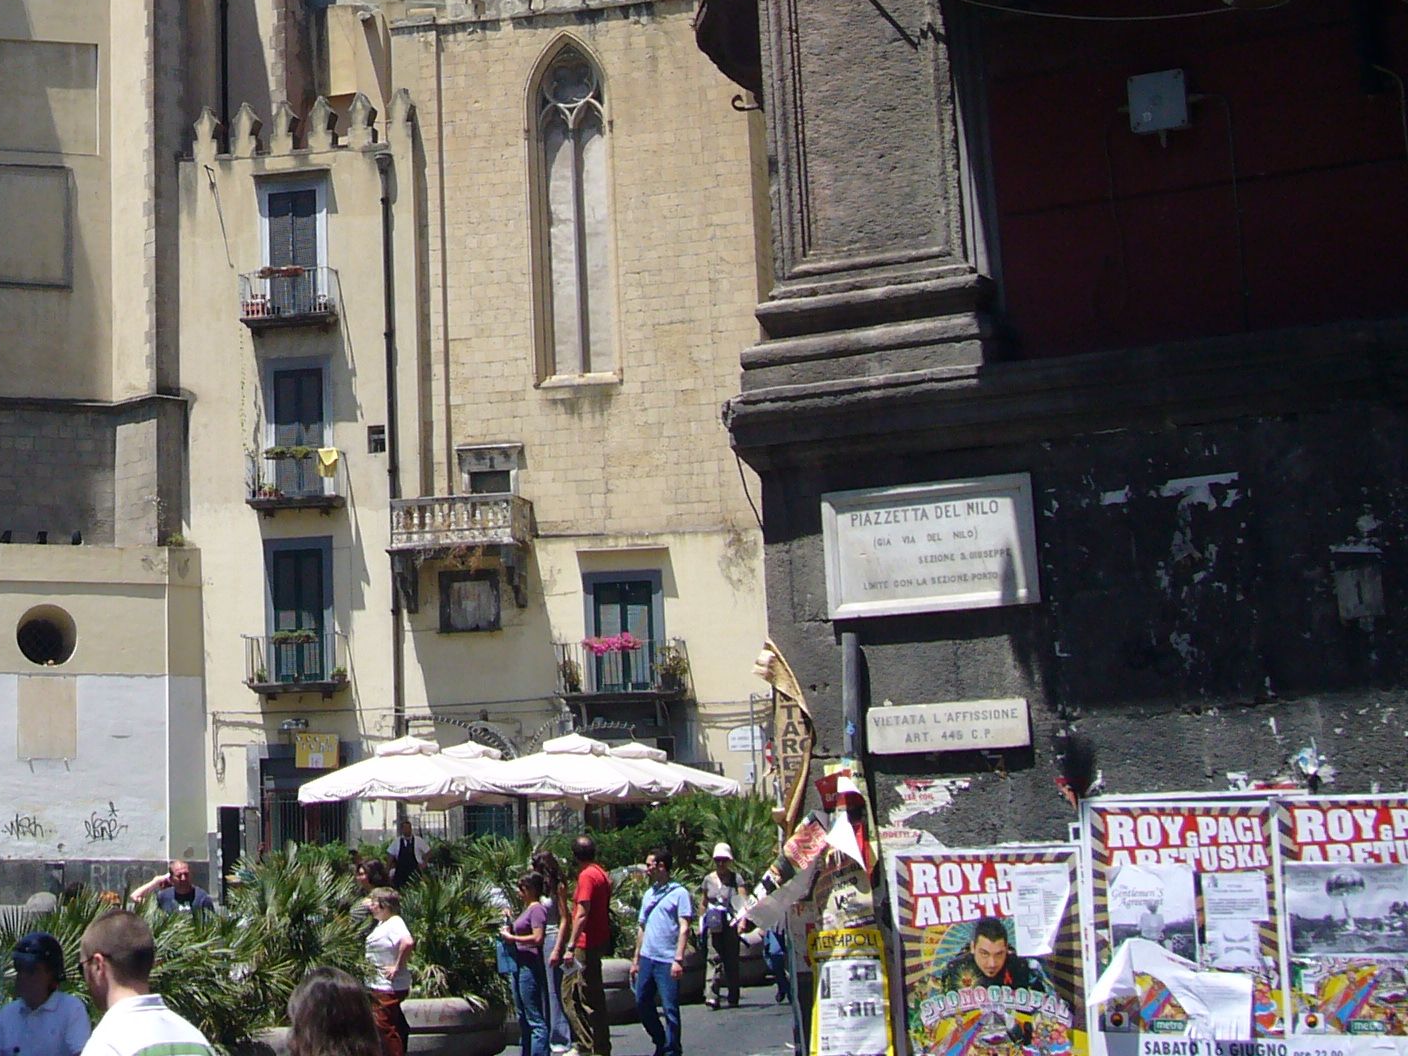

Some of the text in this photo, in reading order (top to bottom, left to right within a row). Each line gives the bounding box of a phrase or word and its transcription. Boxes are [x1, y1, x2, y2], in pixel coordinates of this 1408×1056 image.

[850, 500, 999, 527] PIAZZETTA DEL NILO
[902, 535, 916, 545] VIA
[926, 532, 942, 542] DEL
[952, 526, 979, 541] NILO)
[918, 552, 955, 564] SEZIONE
[894, 578, 914, 588] CON
[916, 577, 928, 586] LA
[931, 573, 969, 585] SEZIONE
[971, 571, 999, 583] PORTO
[873, 714, 926, 727] VIETATA
[905, 731, 934, 743] ART.
[1106, 814, 1263, 848] ROY & PACI
[1294, 808, 1378, 843] ROY
[910, 862, 984, 895] ROY
[914, 891, 1014, 927] ARETU
[1155, 1020, 1185, 1031] metro
[1143, 1040, 1288, 1056] SABATO 16 GIUGNO
